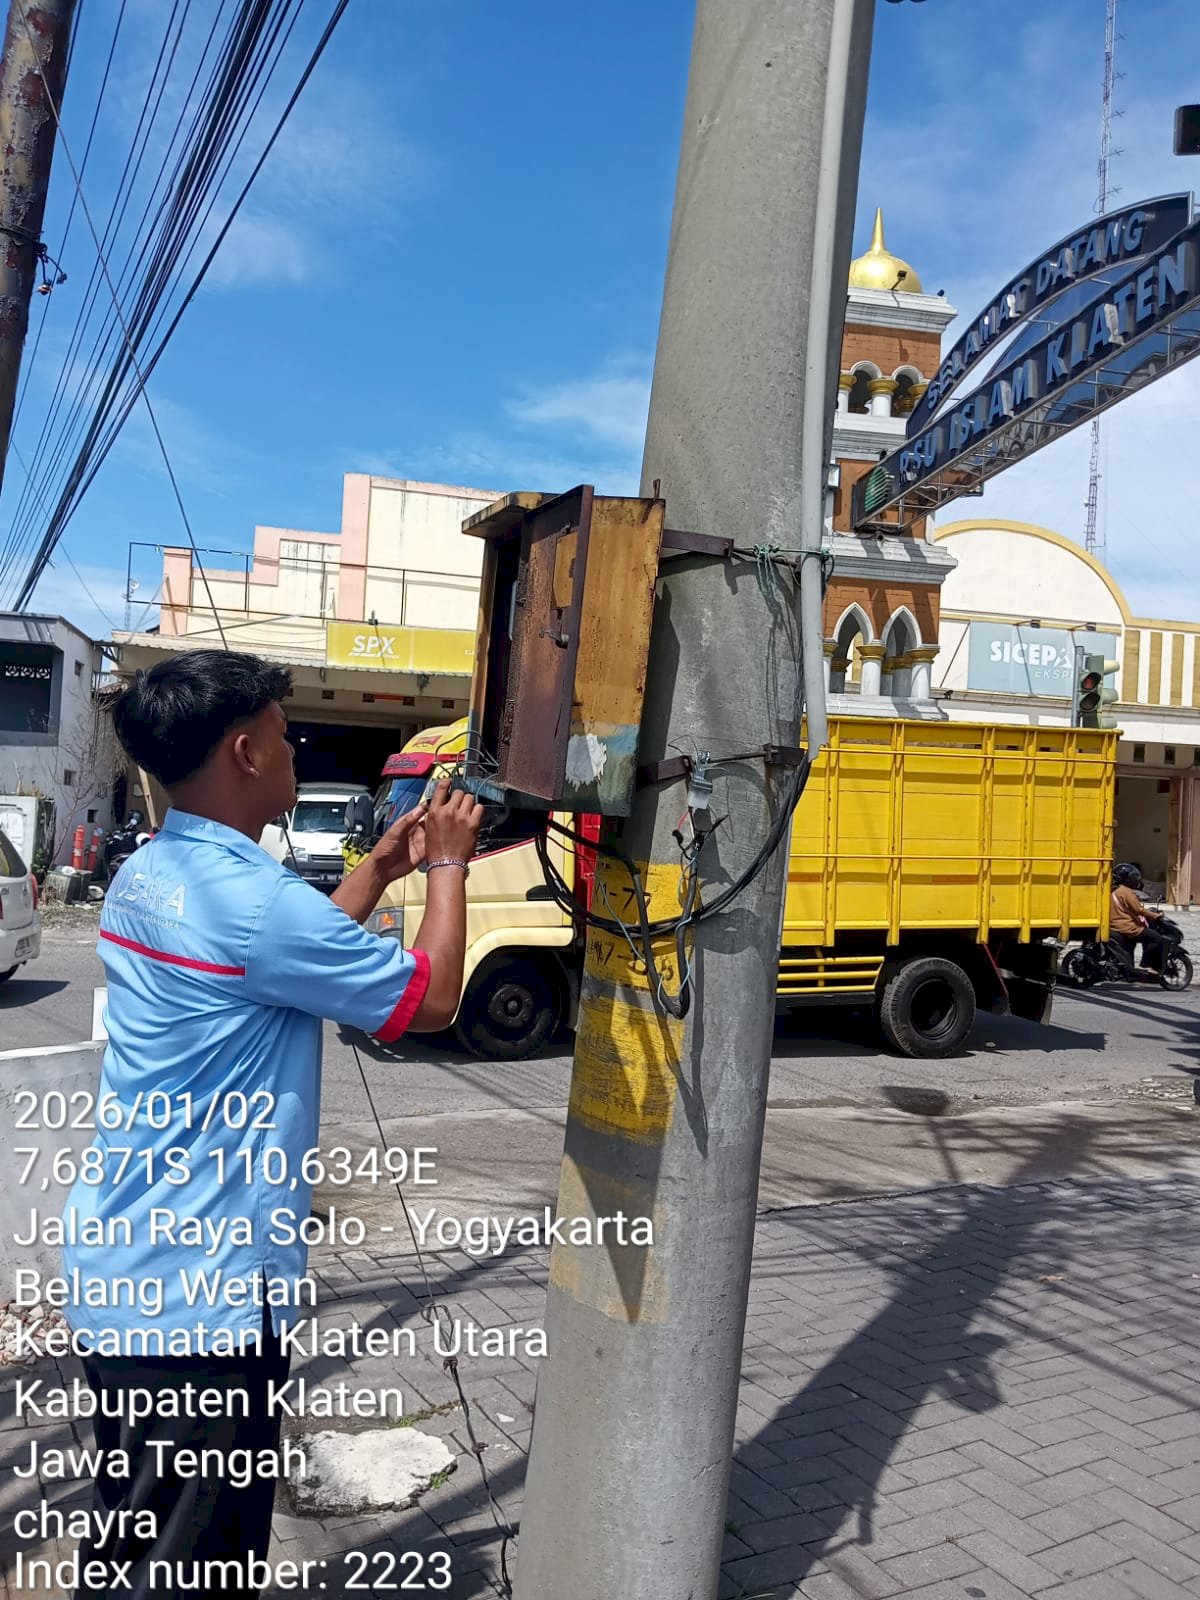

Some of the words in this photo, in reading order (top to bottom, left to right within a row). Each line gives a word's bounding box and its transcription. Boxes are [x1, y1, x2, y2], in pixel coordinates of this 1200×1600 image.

[926, 276, 1030, 410] SELAMAT
[1035, 210, 1148, 300] DATANG
[948, 359, 1038, 450] ISLAM
[1046, 240, 1190, 385] KLATEN
[352, 635, 396, 655] SPX
